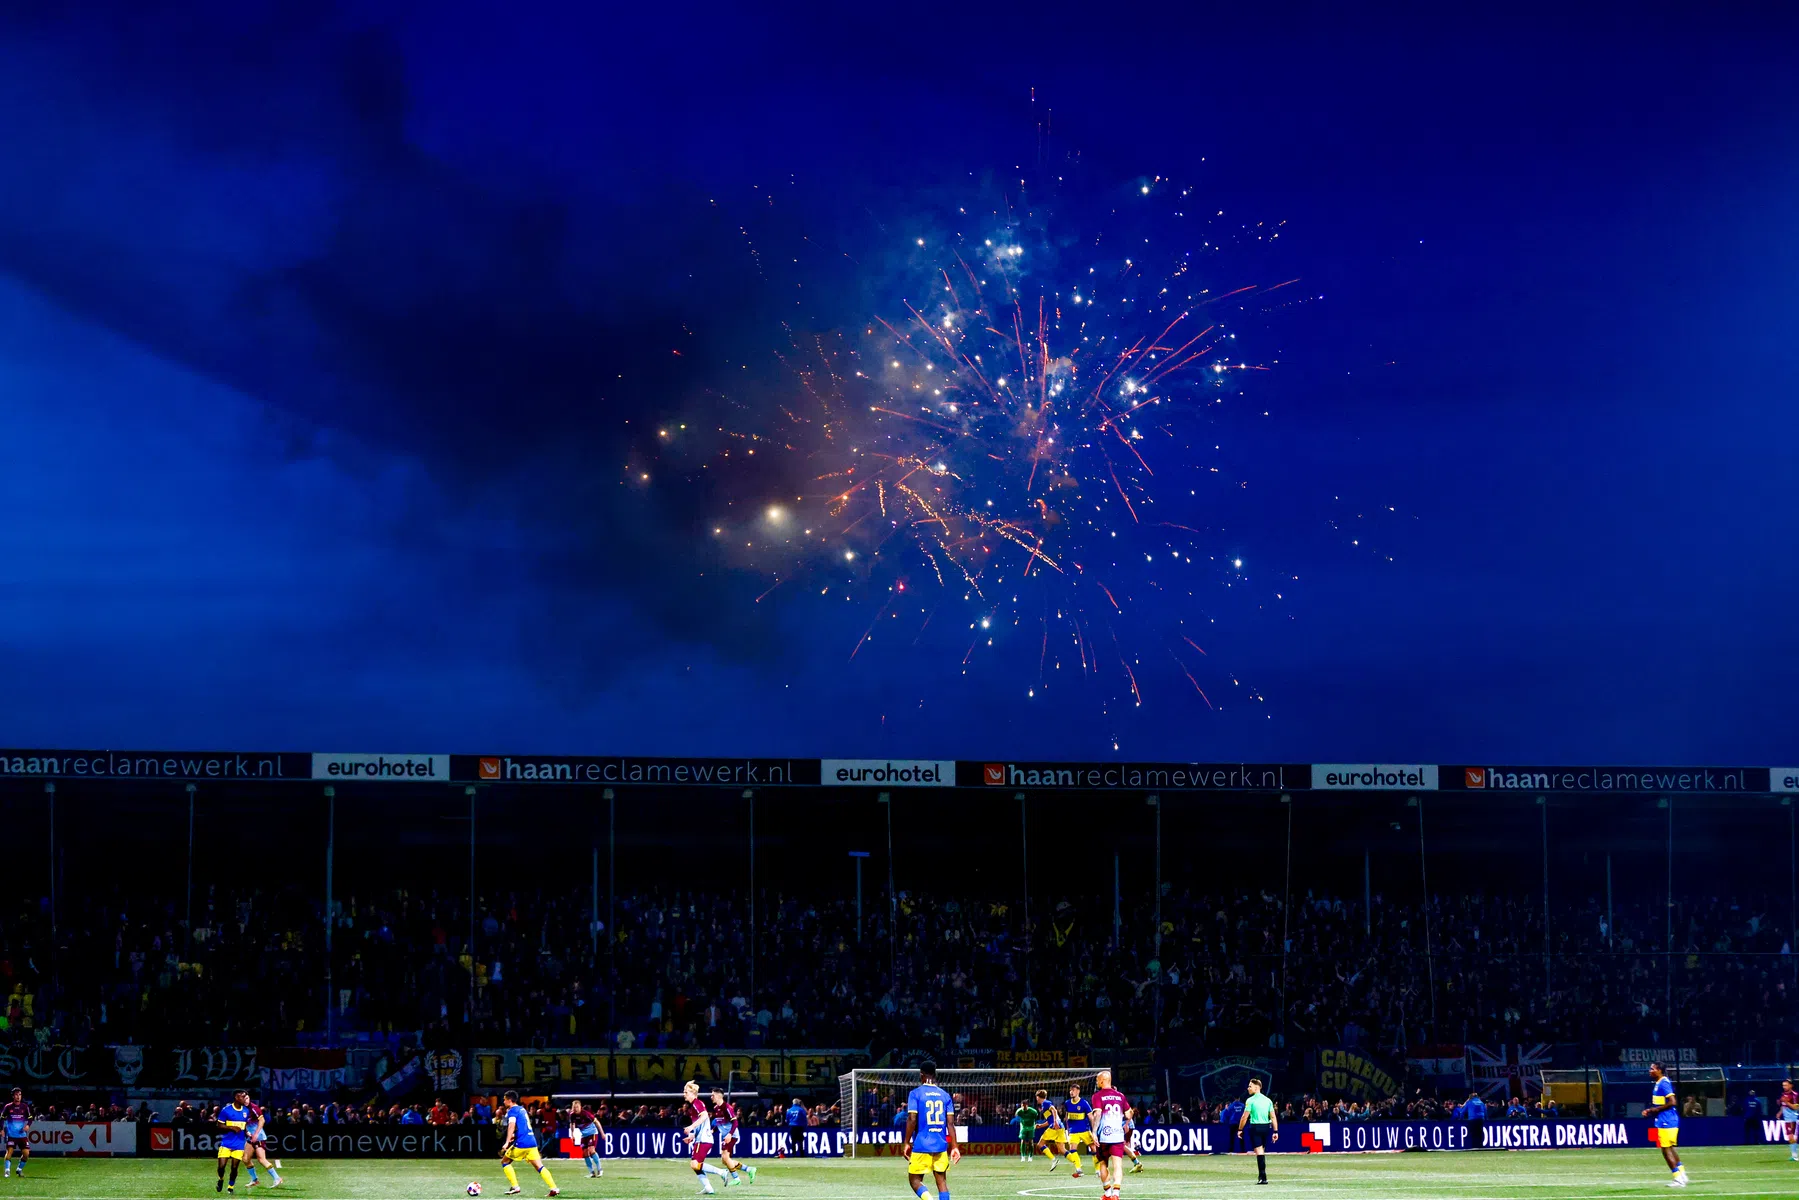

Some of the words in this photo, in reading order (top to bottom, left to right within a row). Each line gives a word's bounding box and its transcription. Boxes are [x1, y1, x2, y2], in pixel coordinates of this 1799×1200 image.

[327, 759, 435, 778] eurohotel
[505, 758, 792, 782] haanreclamewerk.nl
[836, 762, 940, 782] eurohotel
[1009, 764, 1284, 787] haanreclamewerk.nl
[1326, 768, 1425, 787] eurohotel
[1489, 768, 1745, 790] haanreclamewerk.nl
[259, 1067, 344, 1090] CAMBUUR
[925, 1100, 944, 1125] 22
[177, 1127, 483, 1152] haaeclamewerk.nl
[605, 1132, 741, 1155] BOUWG
[837, 1131, 913, 1153] DRAISM
[1343, 1124, 1468, 1149] BOUWGROEP
[1556, 1123, 1628, 1145] DRAISMA
